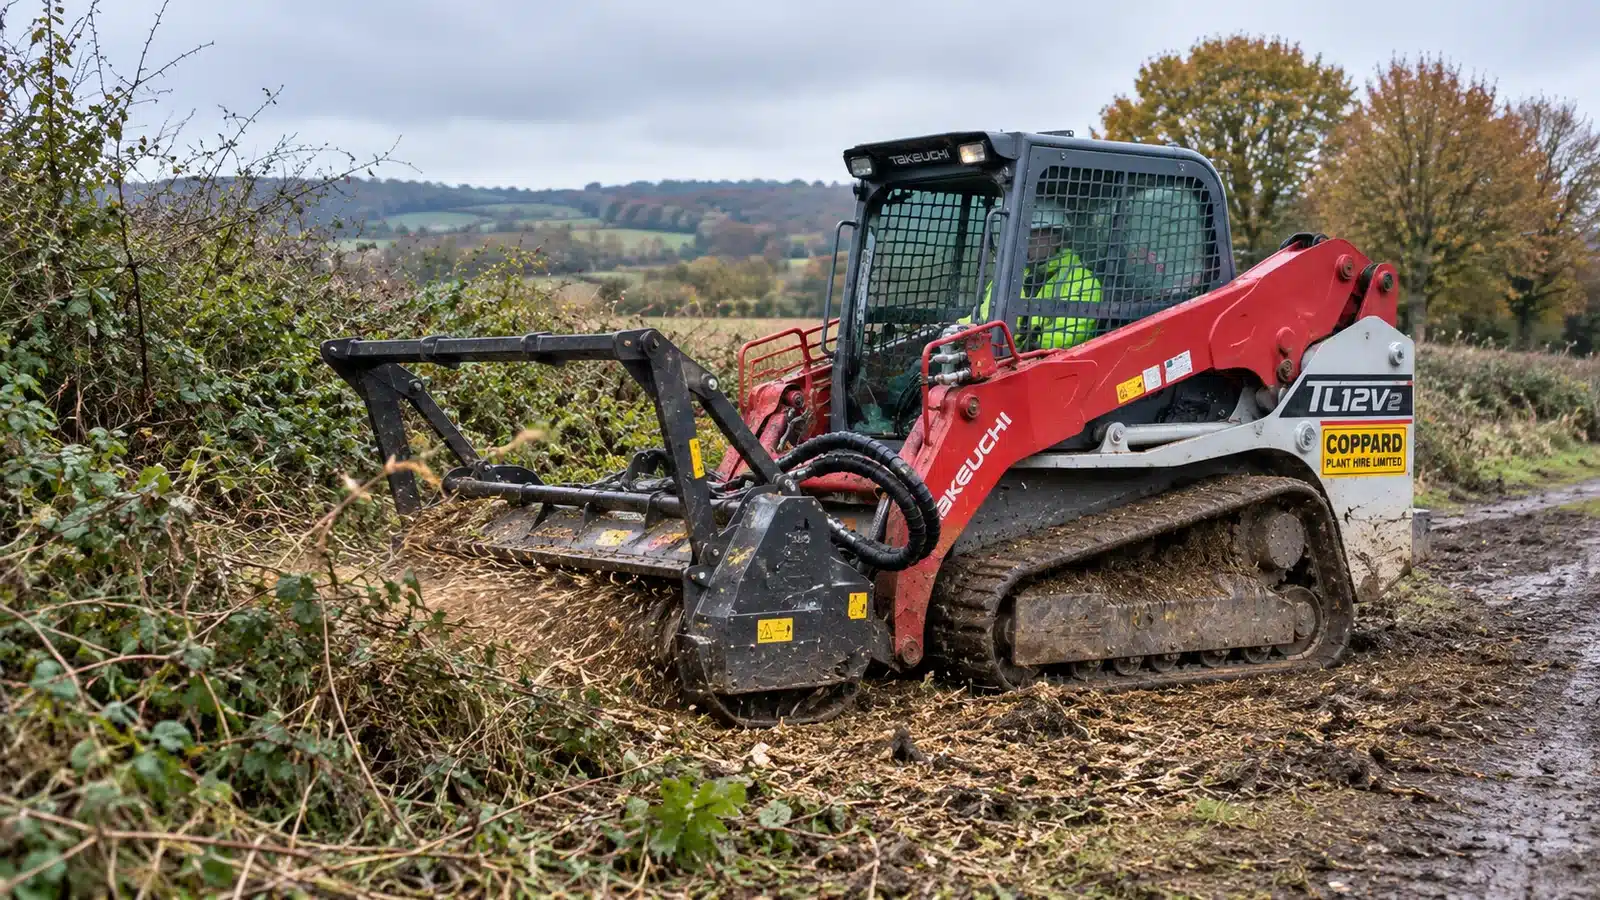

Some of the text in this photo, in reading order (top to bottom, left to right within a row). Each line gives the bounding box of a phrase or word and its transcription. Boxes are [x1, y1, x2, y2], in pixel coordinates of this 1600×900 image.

[1326, 433, 1403, 454] COPPARD
[937, 411, 1012, 520] AKEUCHI
[1326, 457, 1402, 468] PLANT HIRE LIMITED
